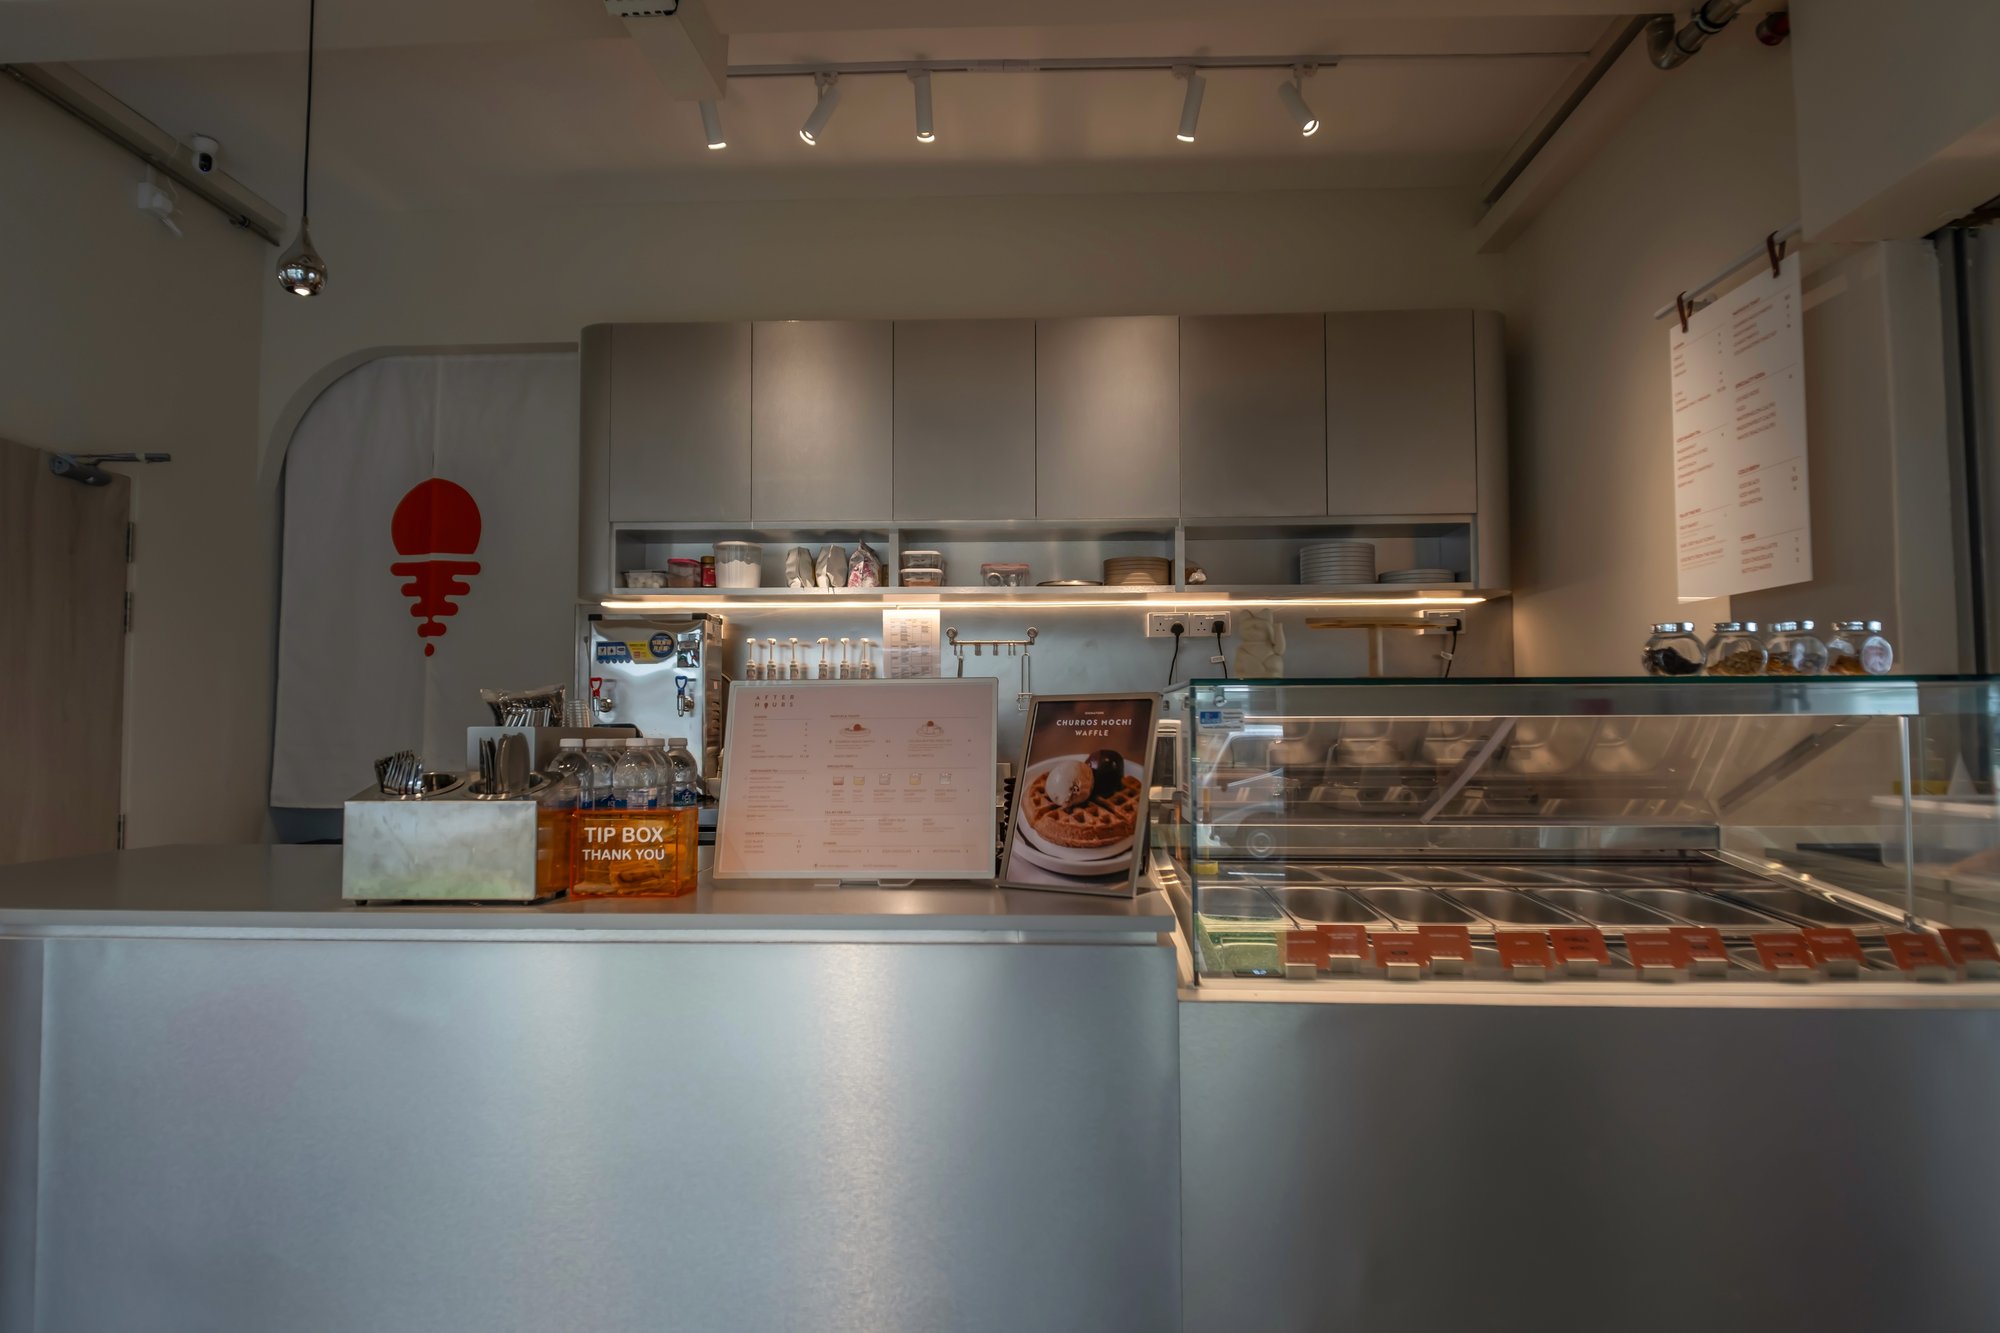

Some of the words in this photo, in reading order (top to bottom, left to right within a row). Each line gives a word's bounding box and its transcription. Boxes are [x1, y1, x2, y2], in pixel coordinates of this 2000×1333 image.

[1101, 718, 1132, 726] MOCHI
[584, 827, 616, 843] TIP
[622, 827, 664, 843] BOX
[582, 849, 632, 860] THANK
[635, 849, 665, 860] YOU
